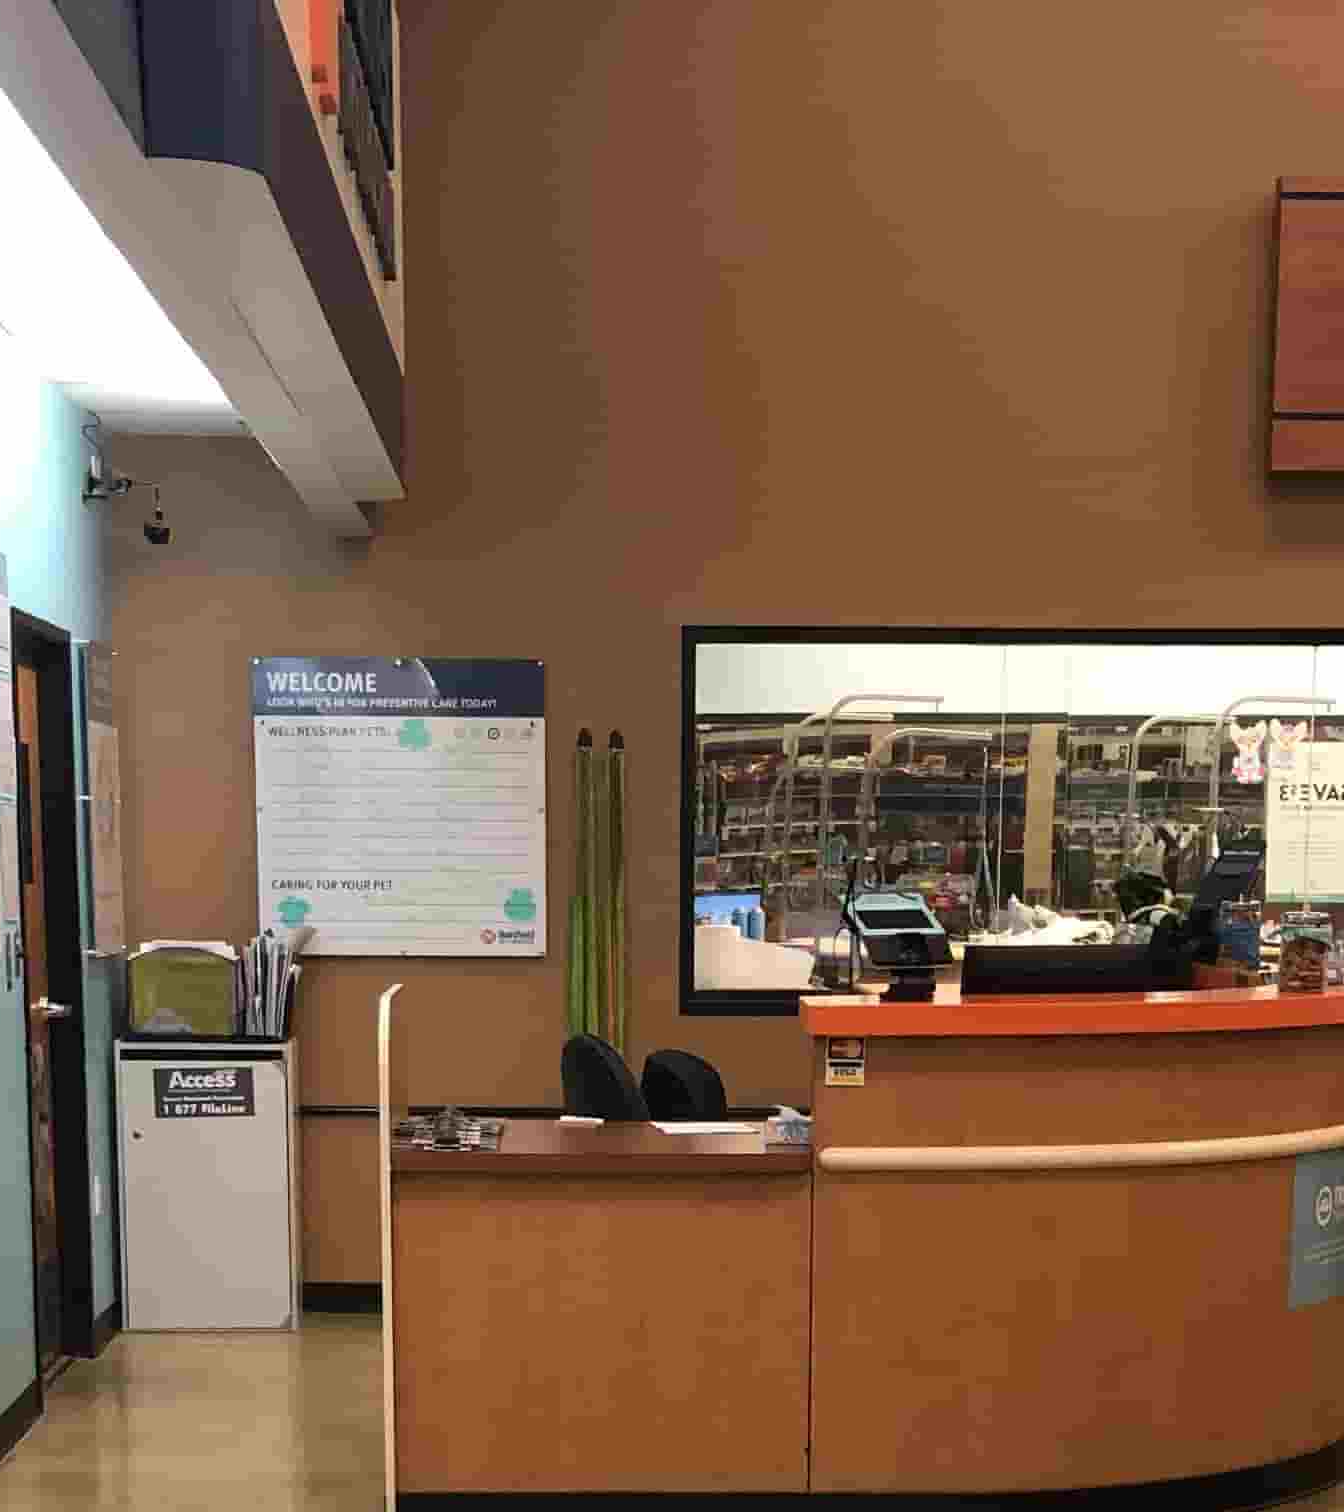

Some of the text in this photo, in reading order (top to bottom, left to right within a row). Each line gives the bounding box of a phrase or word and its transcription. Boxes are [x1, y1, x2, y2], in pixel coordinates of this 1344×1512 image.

[266, 671, 377, 693] WELCOME
[267, 726, 327, 738] WELLNESS
[271, 879, 313, 891] CARING
[316, 879, 339, 890] FOR
[340, 879, 370, 890] YOUR
[168, 1070, 238, 1089] Access
